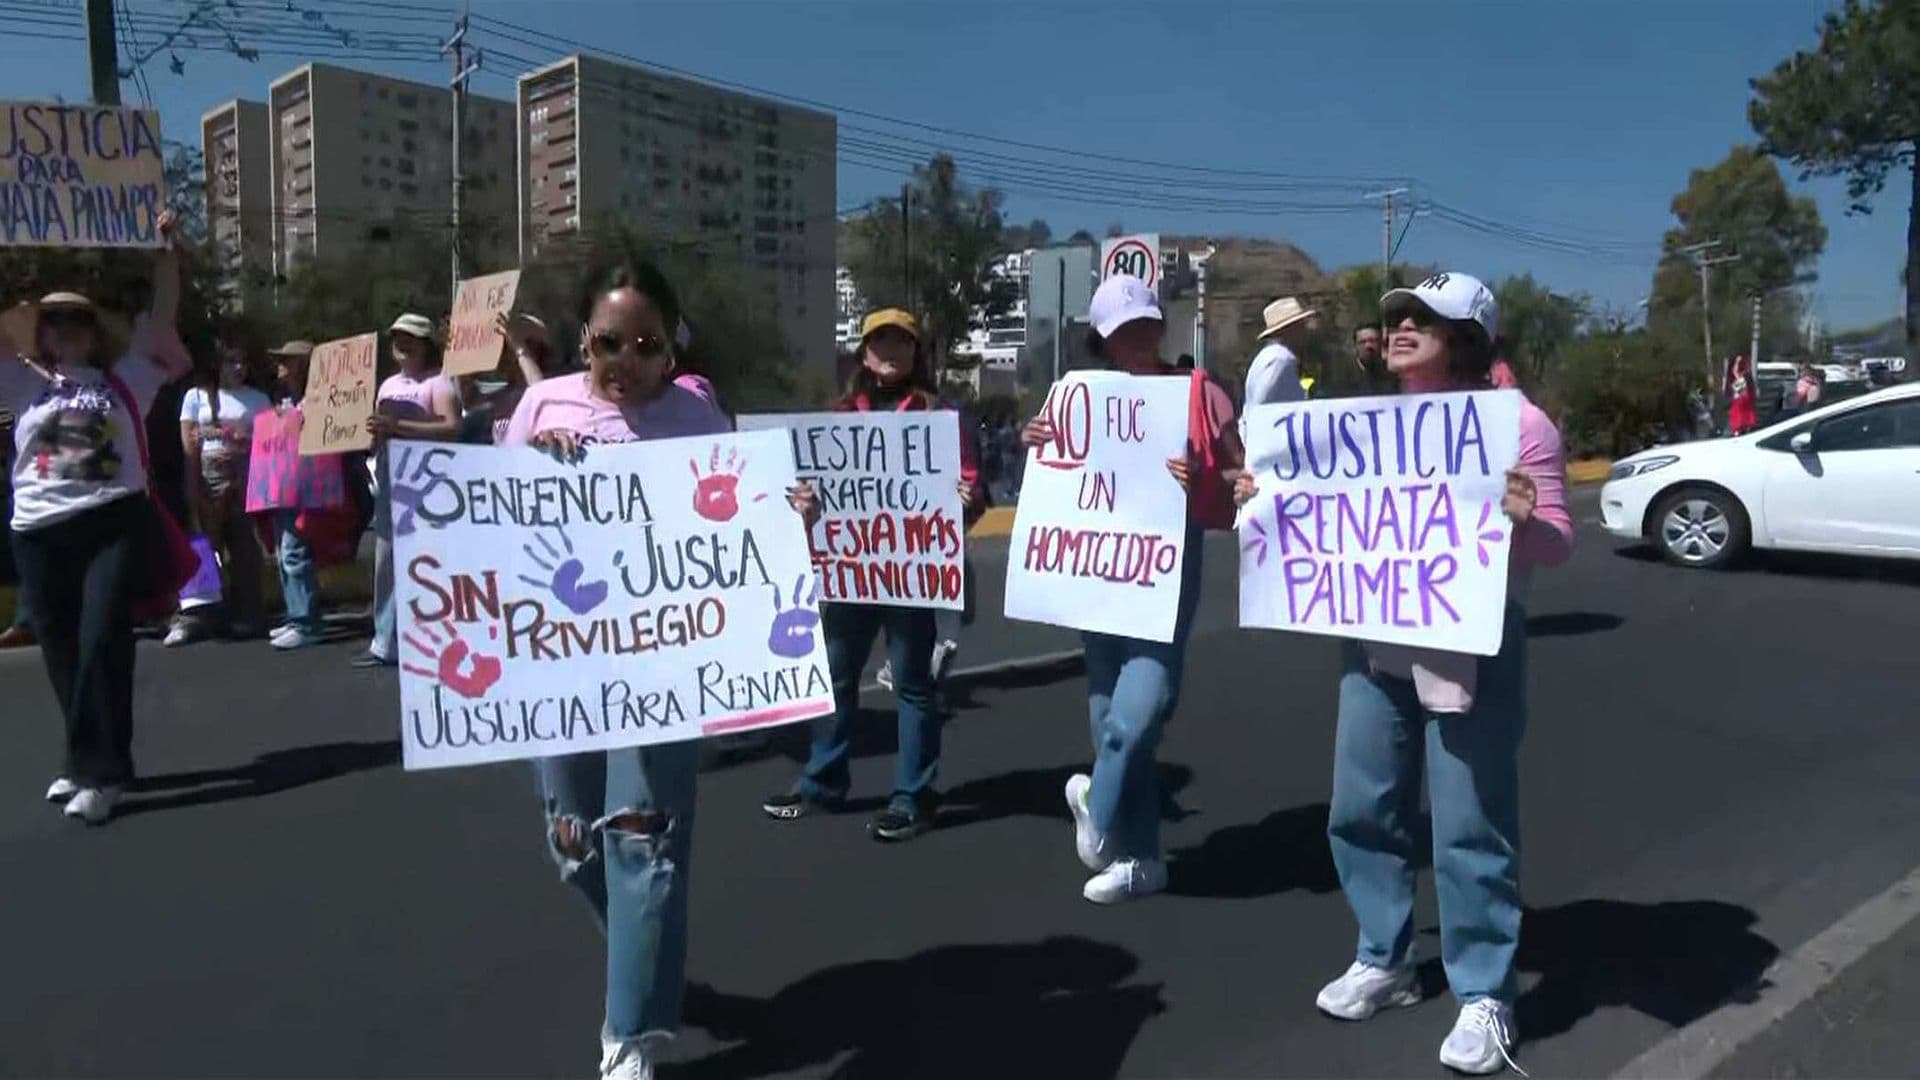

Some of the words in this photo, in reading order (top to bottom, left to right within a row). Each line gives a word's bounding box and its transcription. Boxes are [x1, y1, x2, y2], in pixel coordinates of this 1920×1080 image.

[17, 152, 86, 186] PARA
[791, 425, 887, 474] LESTA
[902, 425, 942, 476] EL
[1035, 382, 1091, 461] NO
[1273, 395, 1491, 480] JUSTICIA
[1077, 470, 1116, 513] UN
[1273, 482, 1461, 556] RENATA
[408, 554, 501, 622] SIN
[1024, 525, 1177, 588] HOMICIDIO
[1283, 553, 1461, 627] PALMER
[502, 596, 725, 661] PRIVILEGIO
[601, 679, 686, 731] PARA
[696, 660, 829, 716] RENATA
